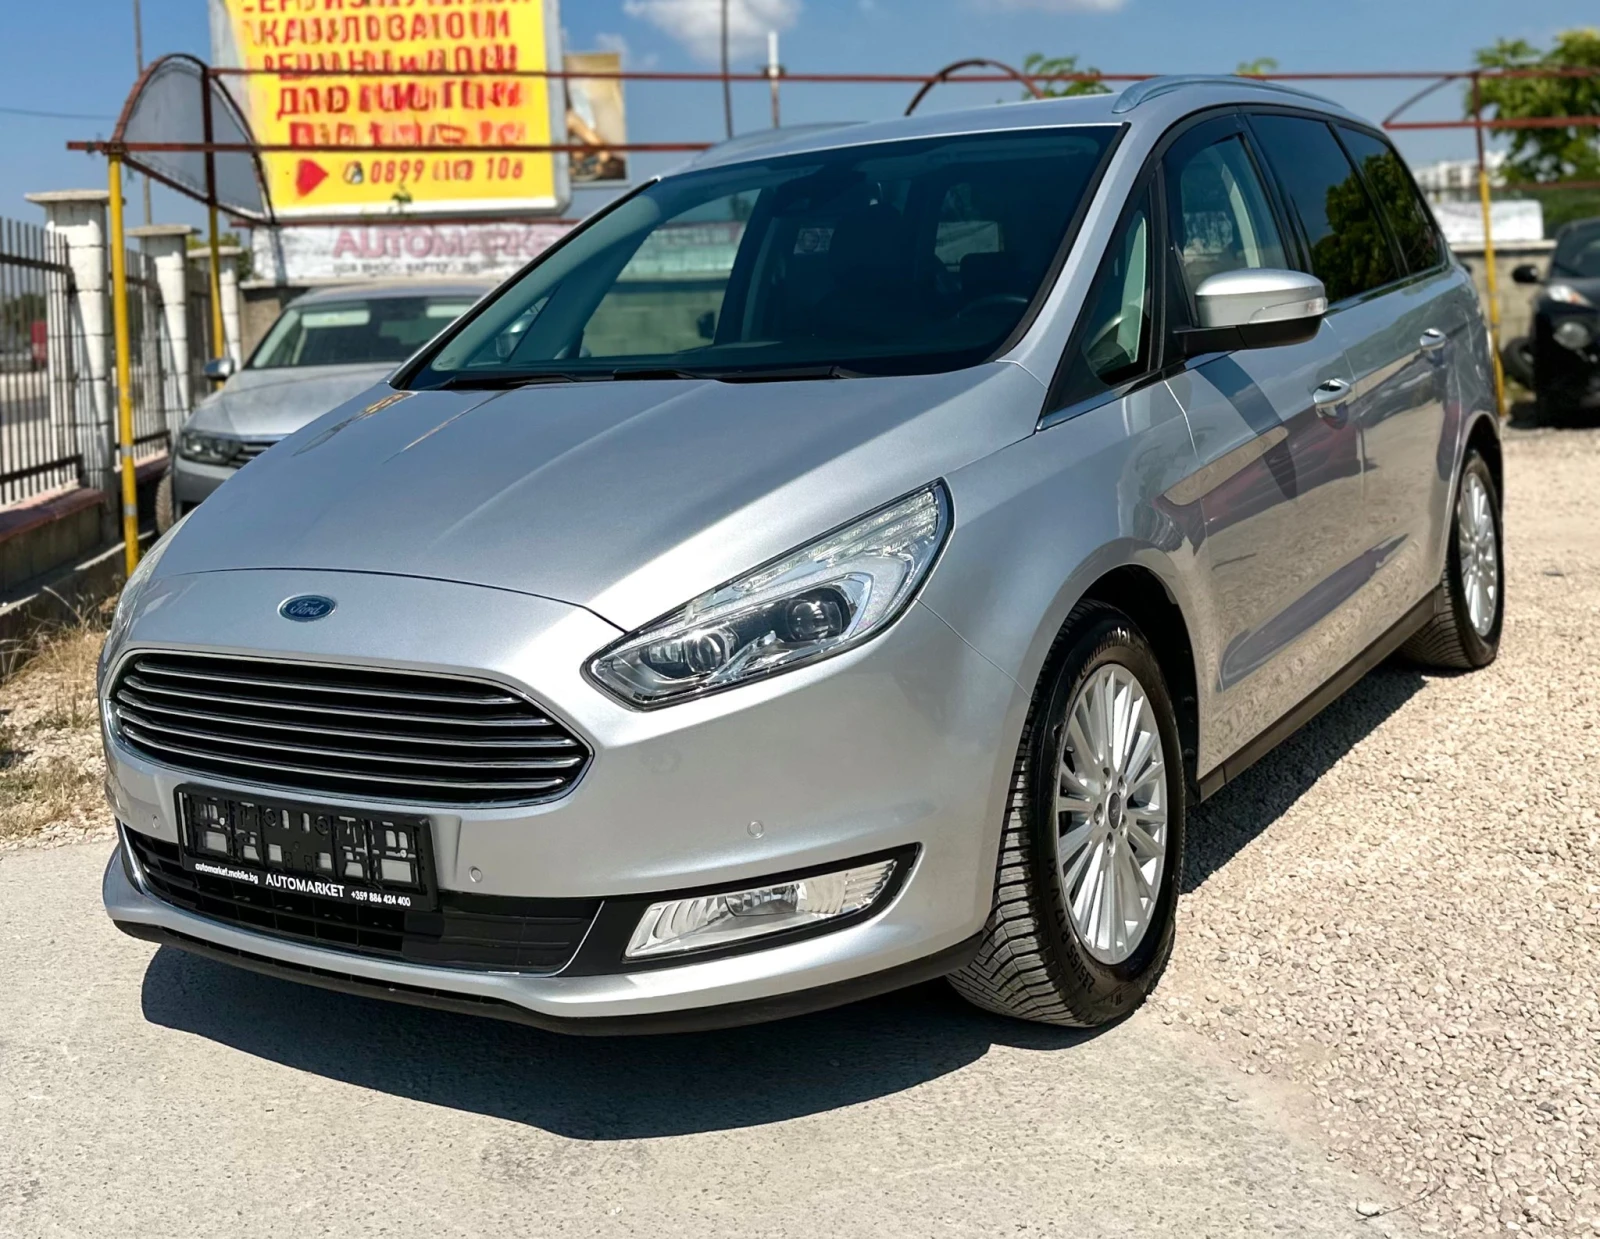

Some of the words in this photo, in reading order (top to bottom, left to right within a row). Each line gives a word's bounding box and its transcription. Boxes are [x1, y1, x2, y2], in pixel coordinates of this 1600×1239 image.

[332, 227, 572, 259] AUTOMARKE
[289, 600, 325, 616] Ford
[194, 862, 259, 885] automarket.mobile.bg
[265, 873, 345, 898] AUTOMARKET
[350, 890, 368, 901] +359
[368, 892, 382, 903] 886
[383, 894, 397, 905] 424
[397, 896, 411, 907] 400
